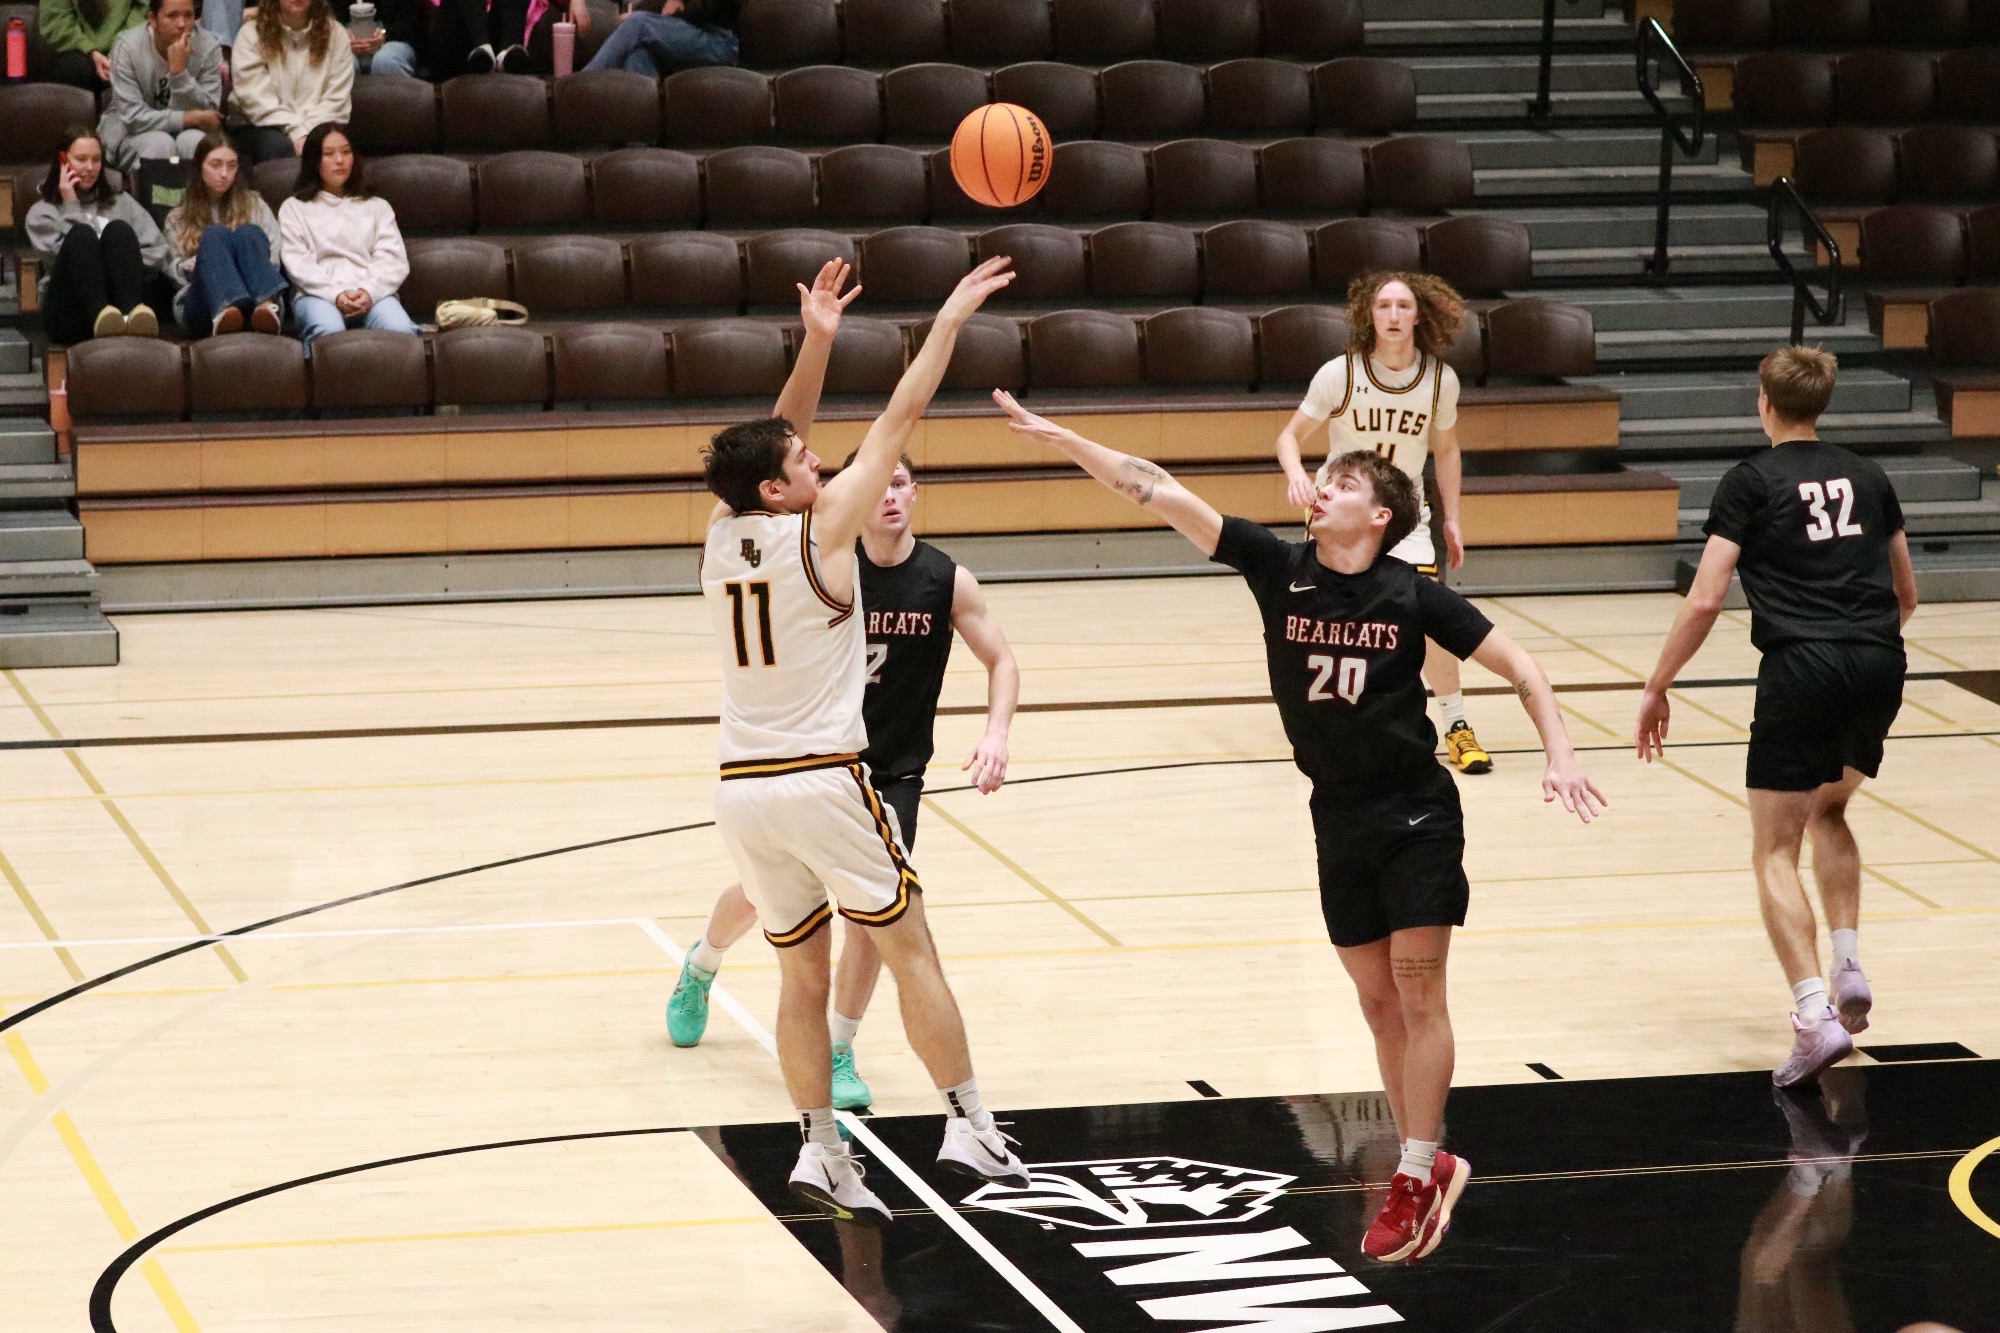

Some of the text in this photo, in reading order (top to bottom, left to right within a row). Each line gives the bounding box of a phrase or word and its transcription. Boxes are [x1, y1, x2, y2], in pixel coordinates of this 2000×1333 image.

[1352, 407, 1428, 436] LUTES
[1798, 477, 1863, 542] 32
[725, 580, 777, 668] 11
[866, 611, 932, 637] RCATS
[1286, 615, 1400, 651] BEARCATS
[1307, 654, 1368, 705] 20
